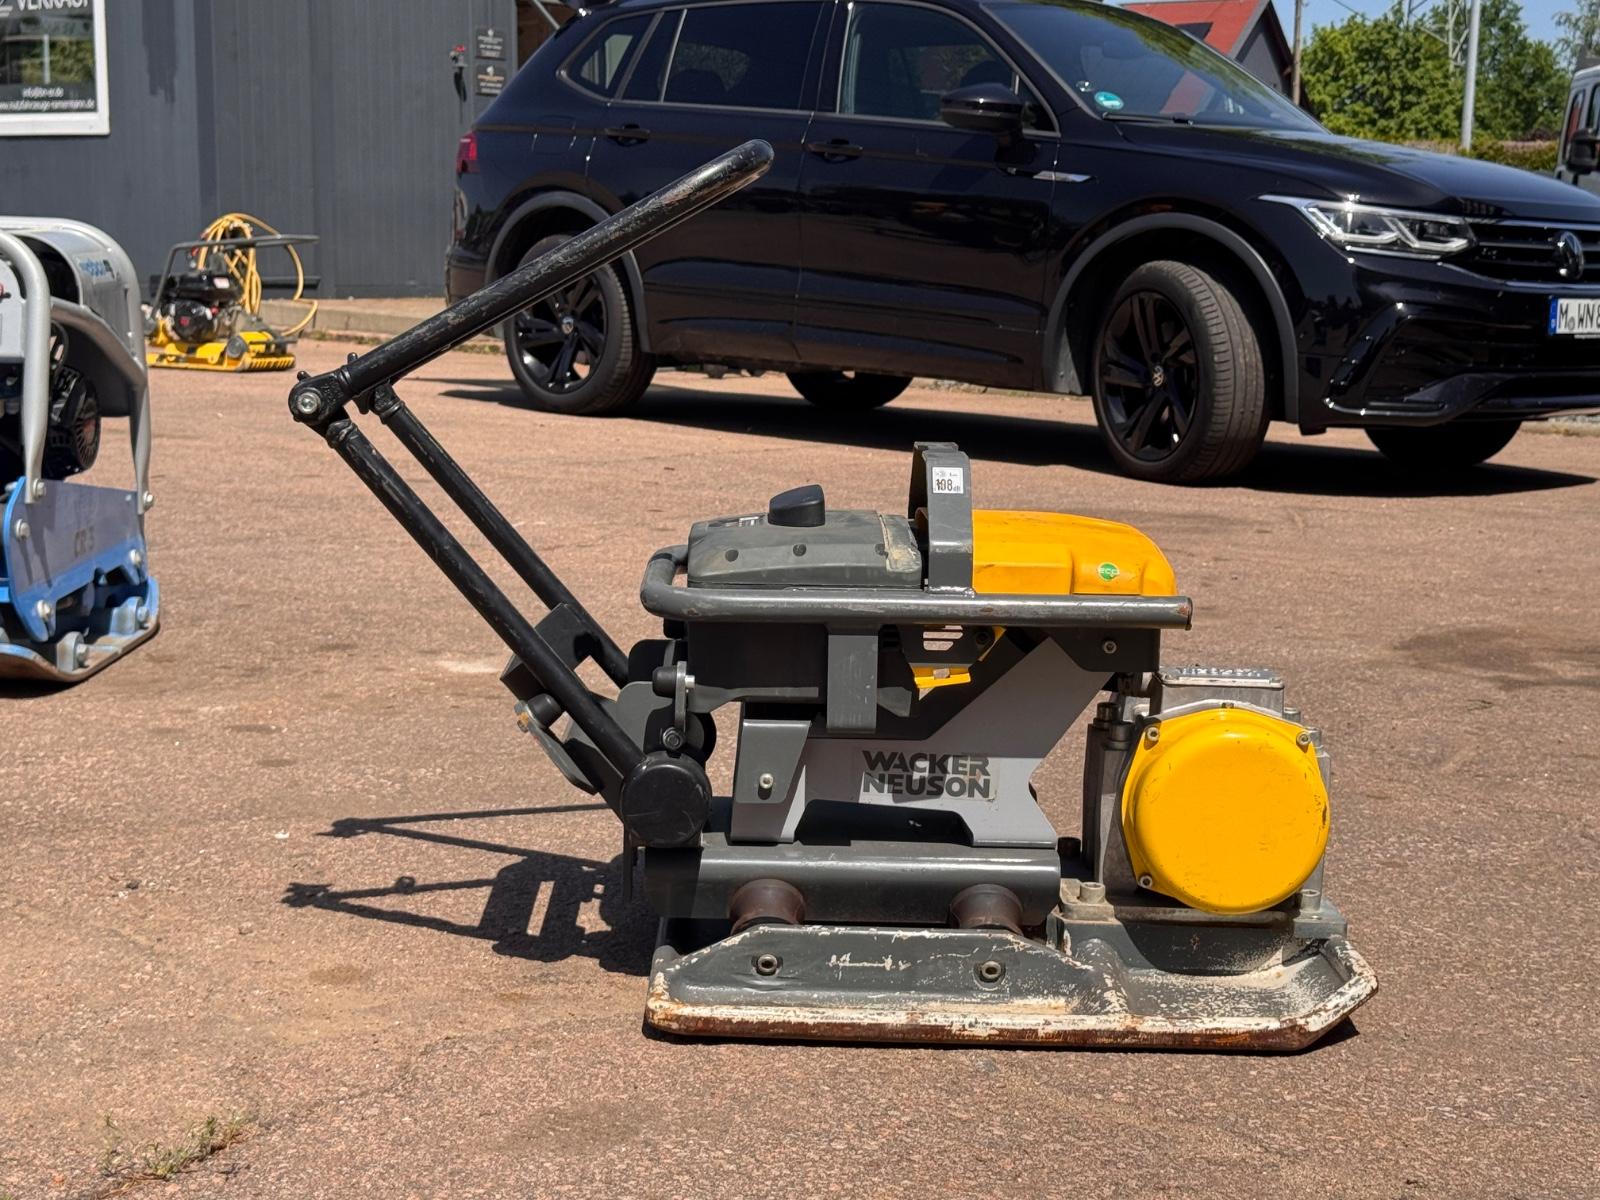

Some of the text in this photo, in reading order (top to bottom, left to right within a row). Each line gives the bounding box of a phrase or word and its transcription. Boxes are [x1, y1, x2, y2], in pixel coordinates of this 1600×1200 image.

[1559, 303, 1569, 329] M
[935, 478, 953, 491] 108
[862, 750, 990, 776] WACKER
[862, 772, 991, 798] NEUSON
